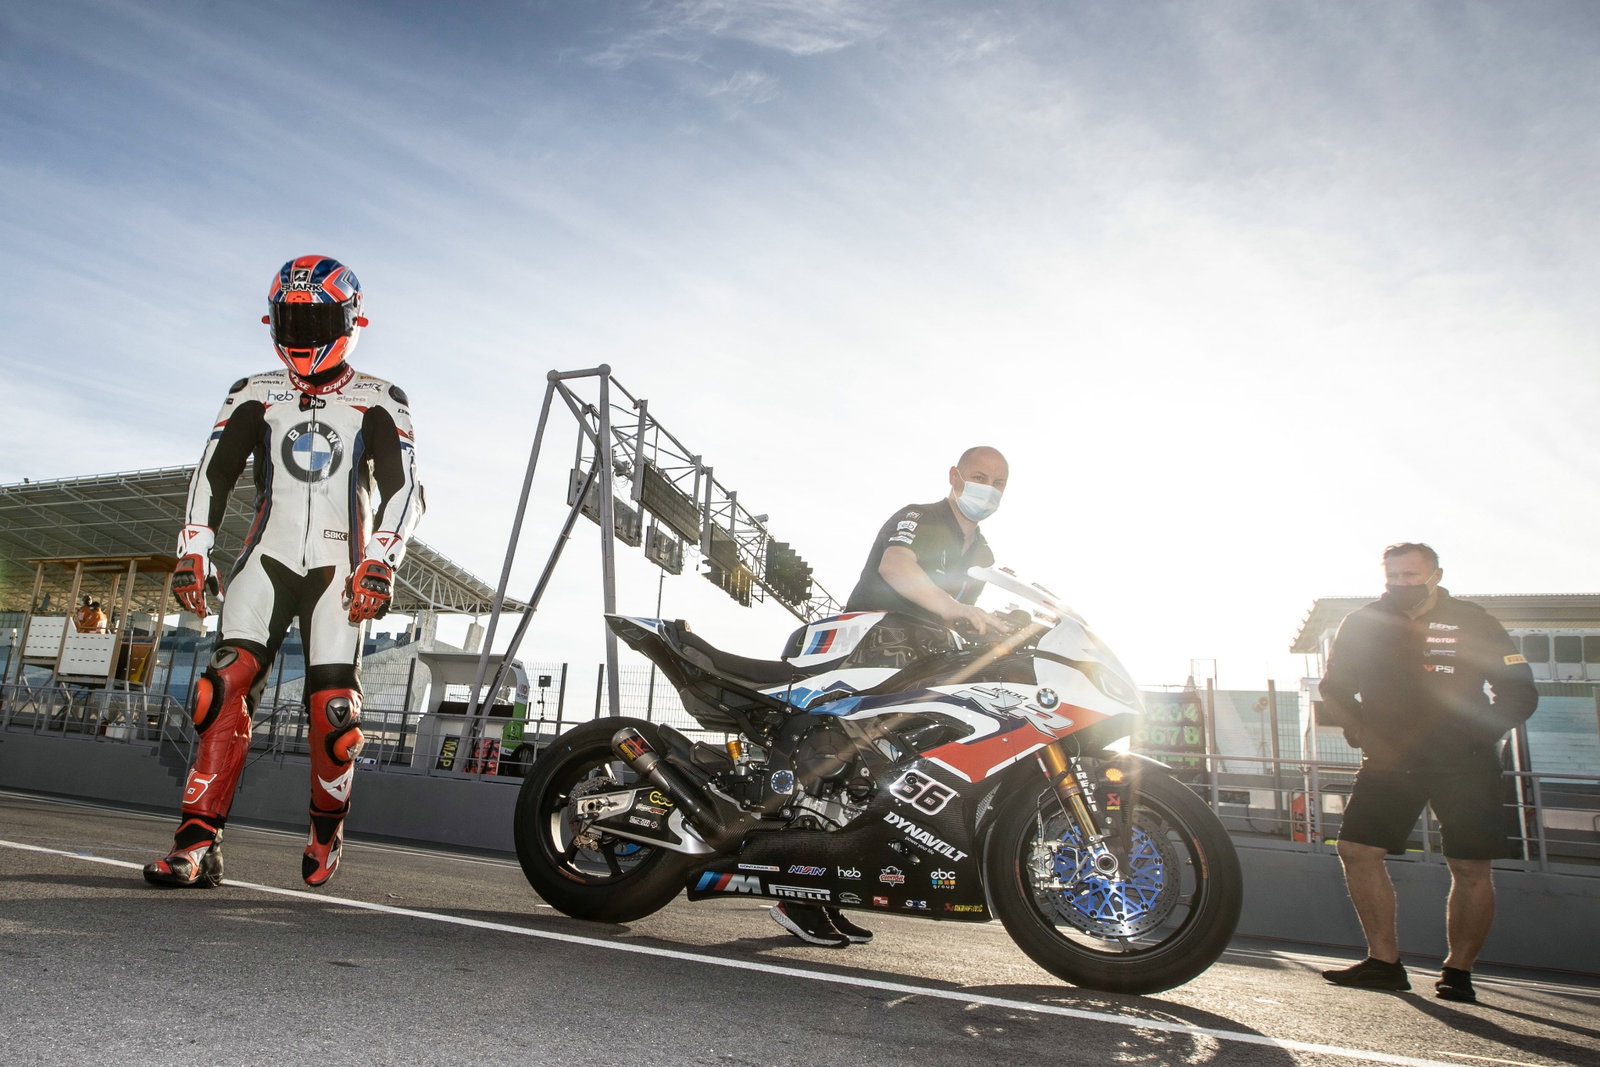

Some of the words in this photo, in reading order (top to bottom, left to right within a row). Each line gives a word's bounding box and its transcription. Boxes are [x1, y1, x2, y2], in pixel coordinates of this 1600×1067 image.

[281, 283, 323, 292] SHARK
[267, 390, 294, 402] heb
[287, 423, 339, 443] BMW
[440, 741, 457, 767] MAP
[883, 811, 968, 862] DYNAVOLT
[837, 865, 862, 878] heb
[930, 867, 956, 880] ebc
[768, 883, 831, 901] PIRELLI
